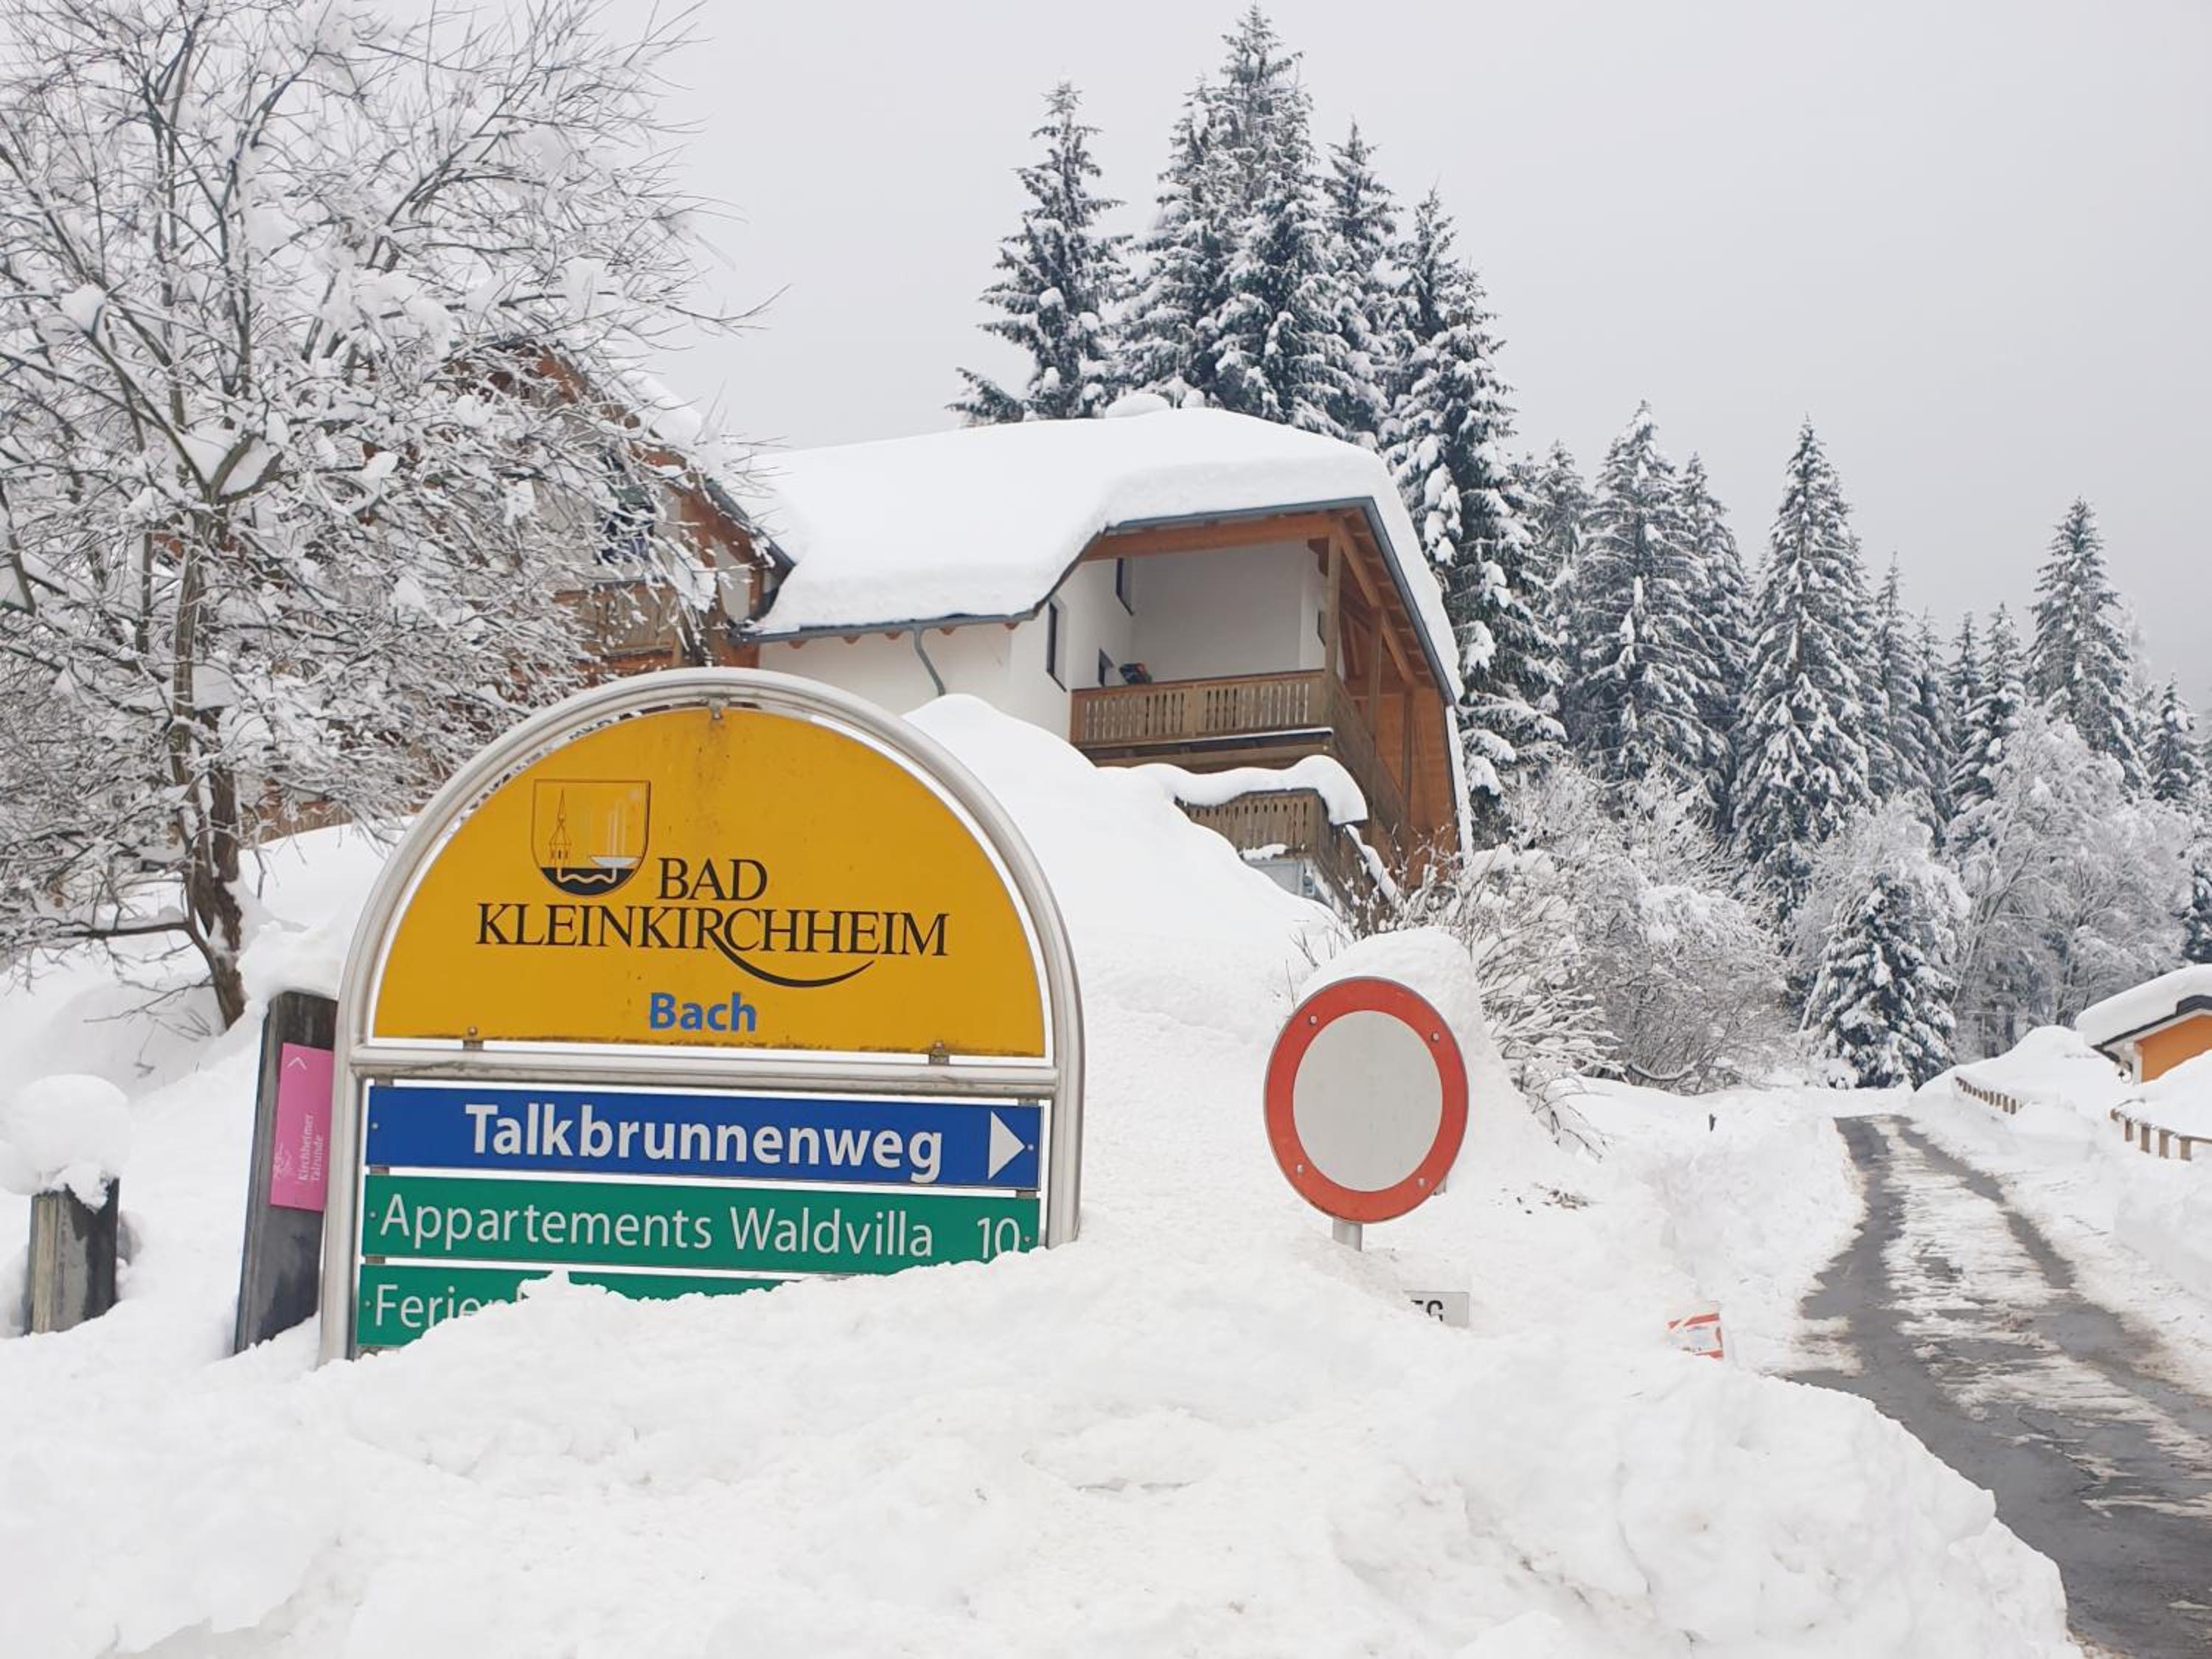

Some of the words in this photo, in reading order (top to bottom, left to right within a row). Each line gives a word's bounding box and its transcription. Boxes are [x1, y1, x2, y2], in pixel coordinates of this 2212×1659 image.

[657, 858, 768, 901] BAD
[476, 902, 949, 987] KLEINKIRCHHEIM
[650, 993, 756, 1031] Bach
[465, 1102, 942, 1183] Talkbrunnenweg
[380, 1193, 712, 1251] Appartements
[730, 1207, 932, 1257] Waldvilla
[977, 1217, 1020, 1259] 10
